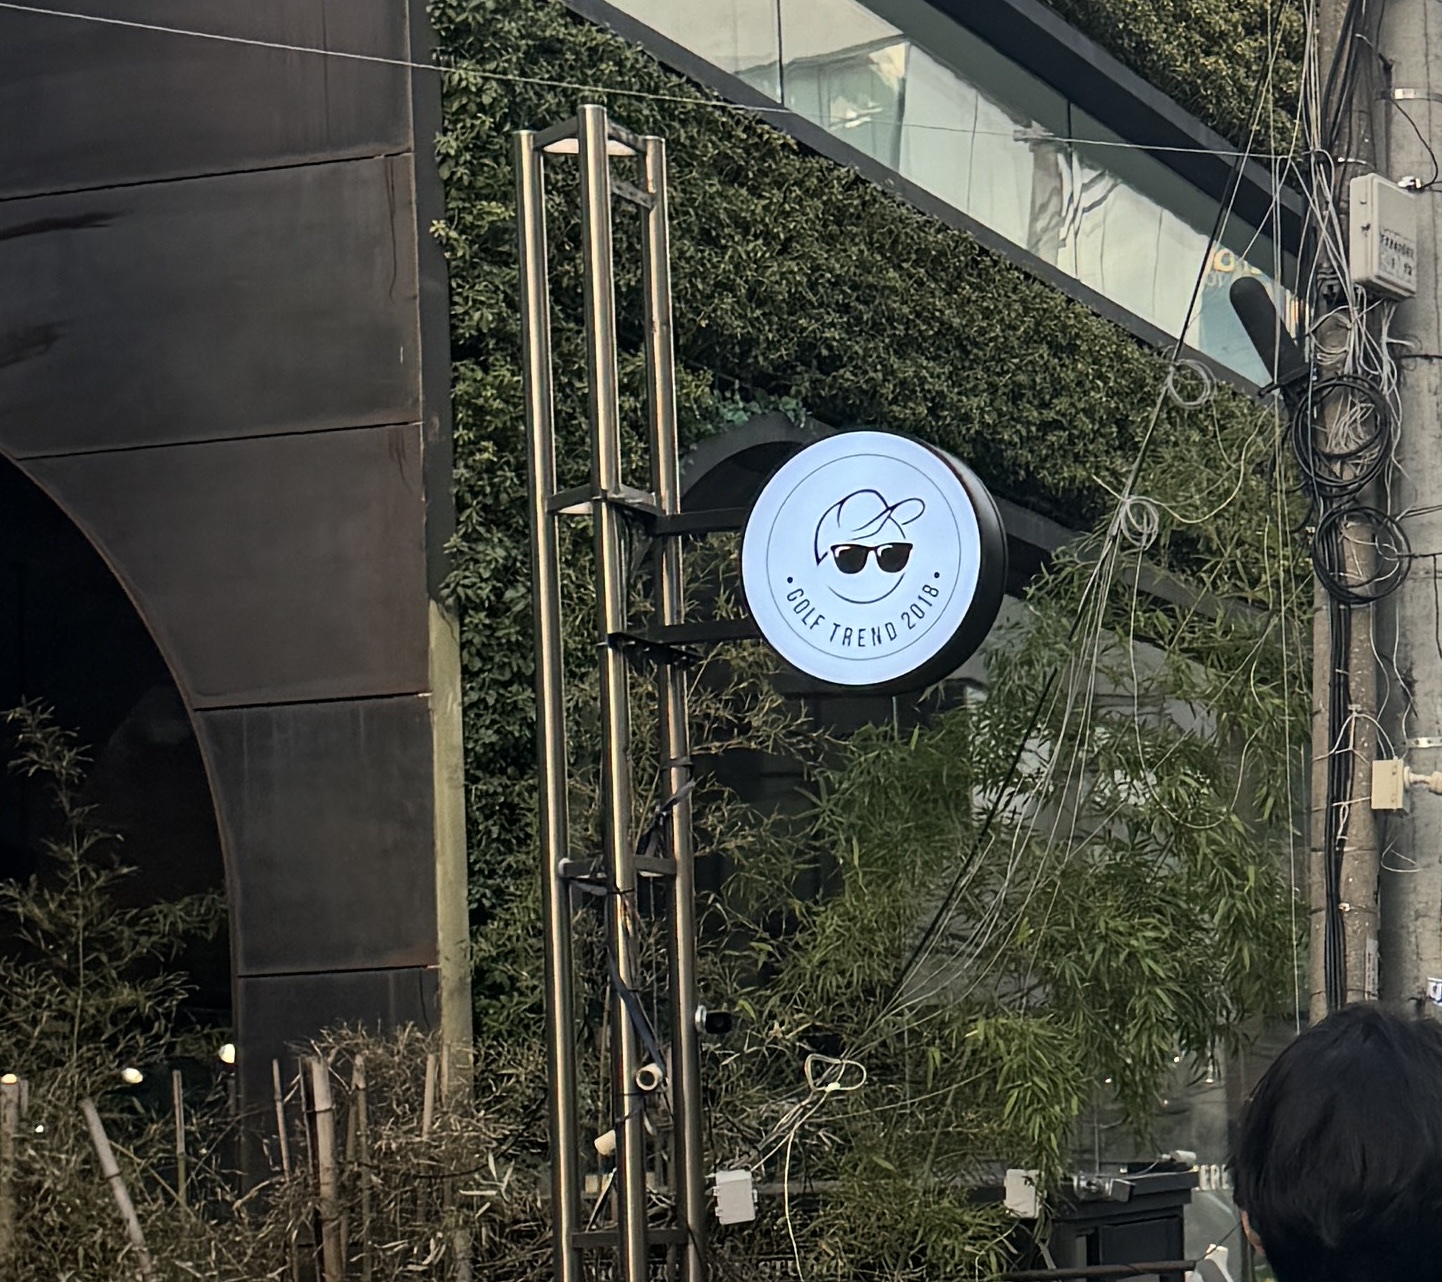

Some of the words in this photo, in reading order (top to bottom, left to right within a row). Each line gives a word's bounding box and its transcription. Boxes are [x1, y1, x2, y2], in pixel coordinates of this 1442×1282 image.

[786, 587, 826, 630] GOLF
[829, 621, 898, 648] TREND
[900, 584, 940, 630] 2018
